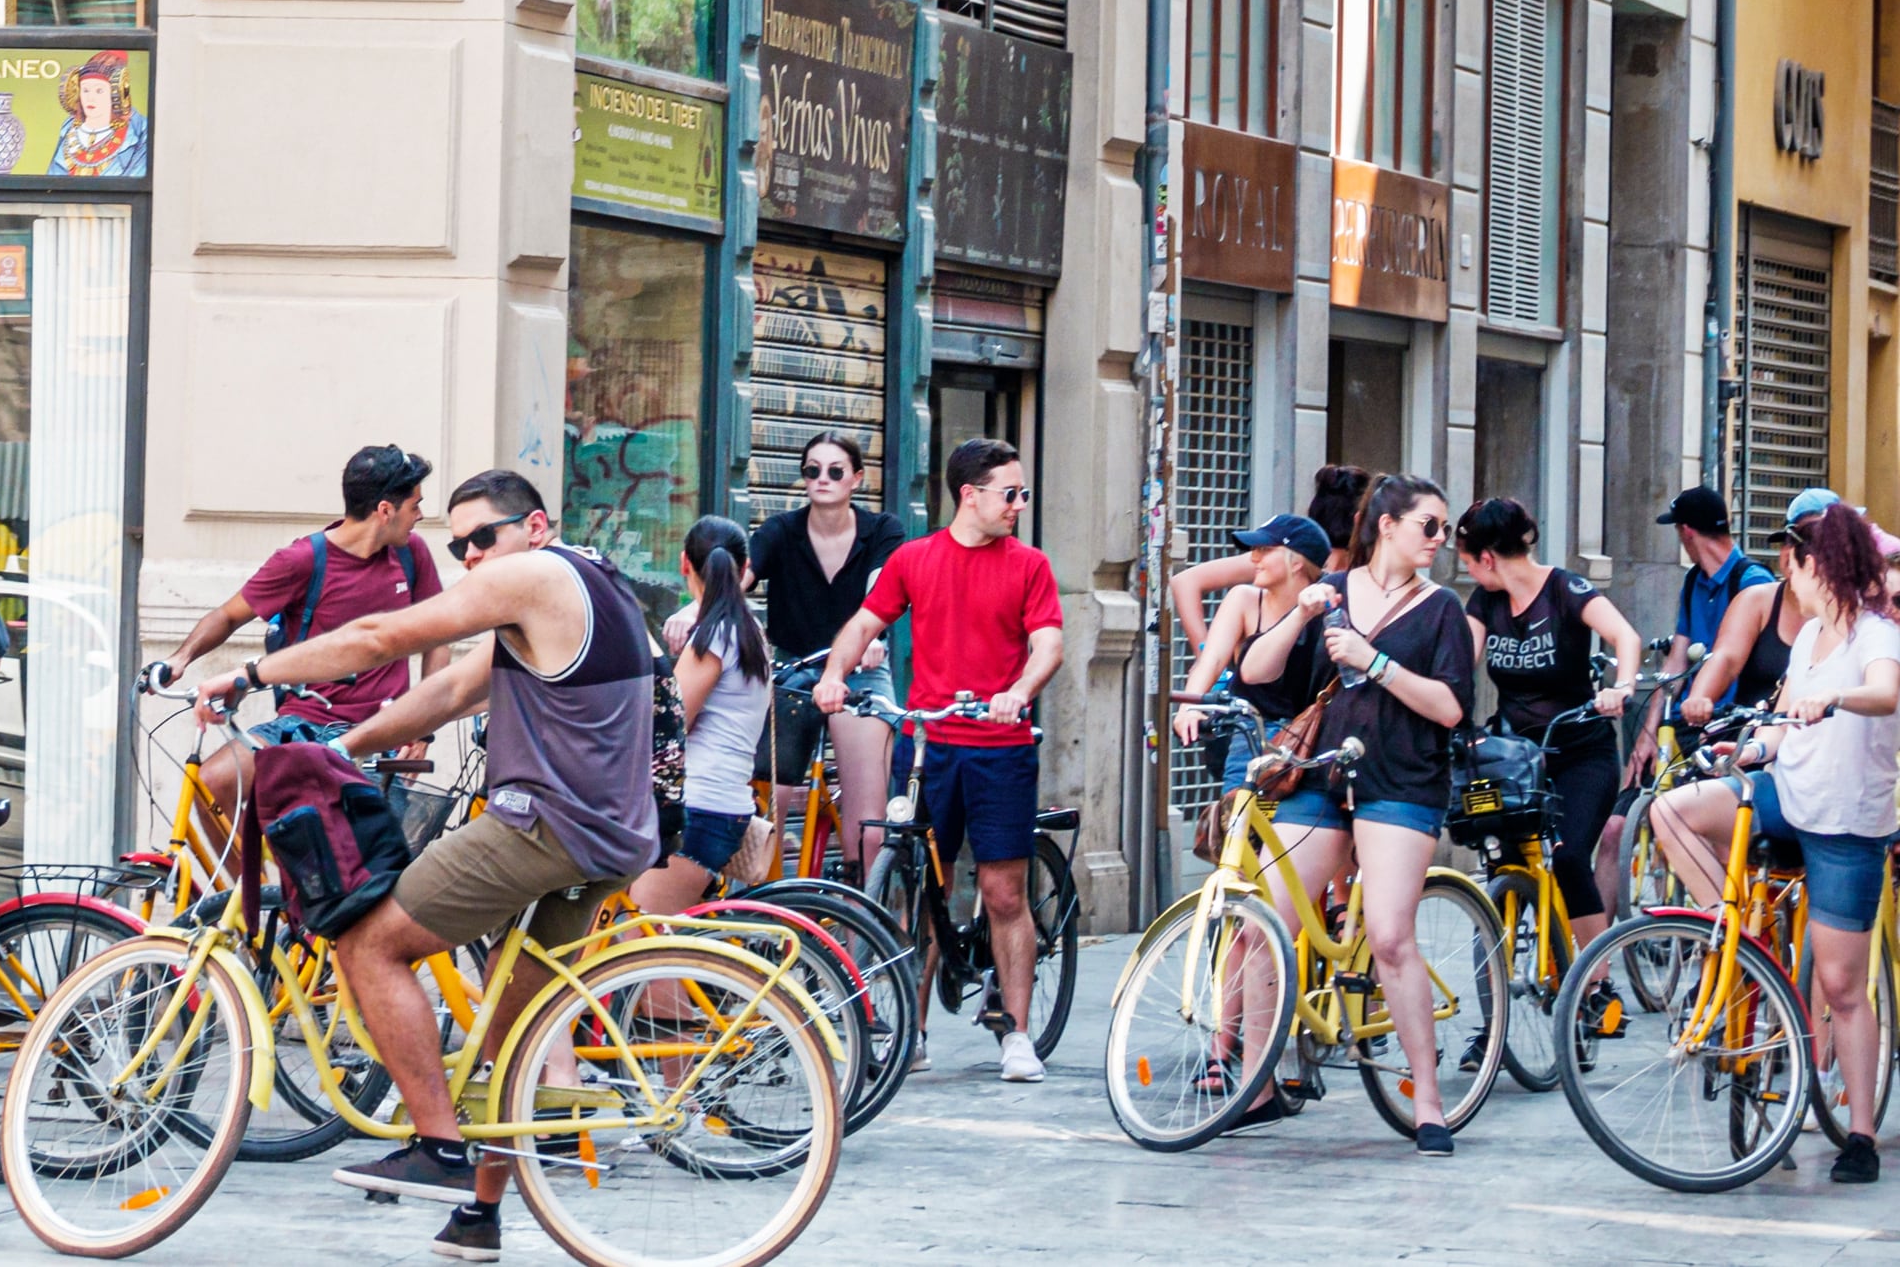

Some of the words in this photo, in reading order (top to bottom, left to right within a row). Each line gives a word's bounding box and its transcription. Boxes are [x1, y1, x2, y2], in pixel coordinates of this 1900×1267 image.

[590, 83, 645, 117] INCIENSO
[646, 97, 669, 124] DEL
[671, 101, 703, 130] TIBET
[770, 63, 835, 161] Yerbas
[837, 78, 892, 174] Vivas
[1191, 169, 1284, 251] ROYAL
[1332, 197, 1446, 282] PERFUMERÍA
[1487, 632, 1554, 654] OREGON
